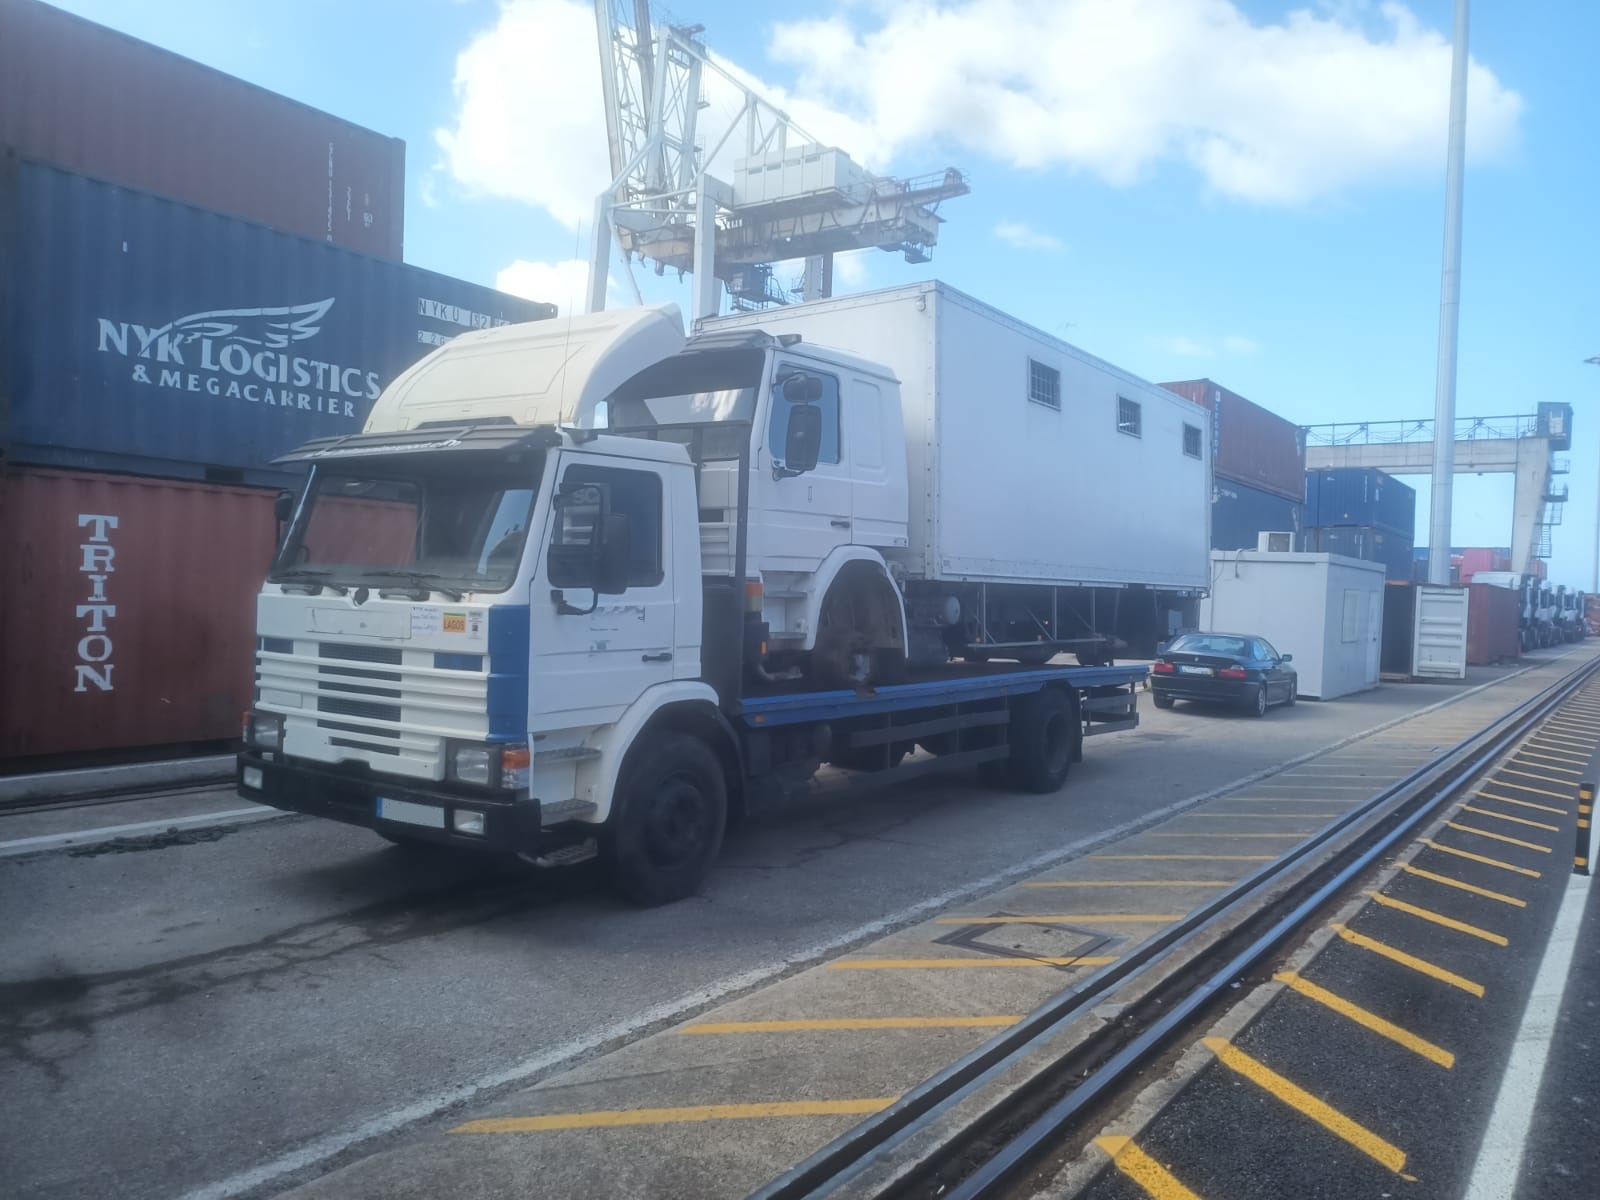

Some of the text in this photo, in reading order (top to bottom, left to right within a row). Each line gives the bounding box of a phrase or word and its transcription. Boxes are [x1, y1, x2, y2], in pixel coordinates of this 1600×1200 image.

[418, 299, 460, 322] NYKU
[97, 318, 381, 400] NYK LOGISTICS
[132, 364, 355, 418] & MEGACARRIER
[74, 513, 119, 692] TRITON
